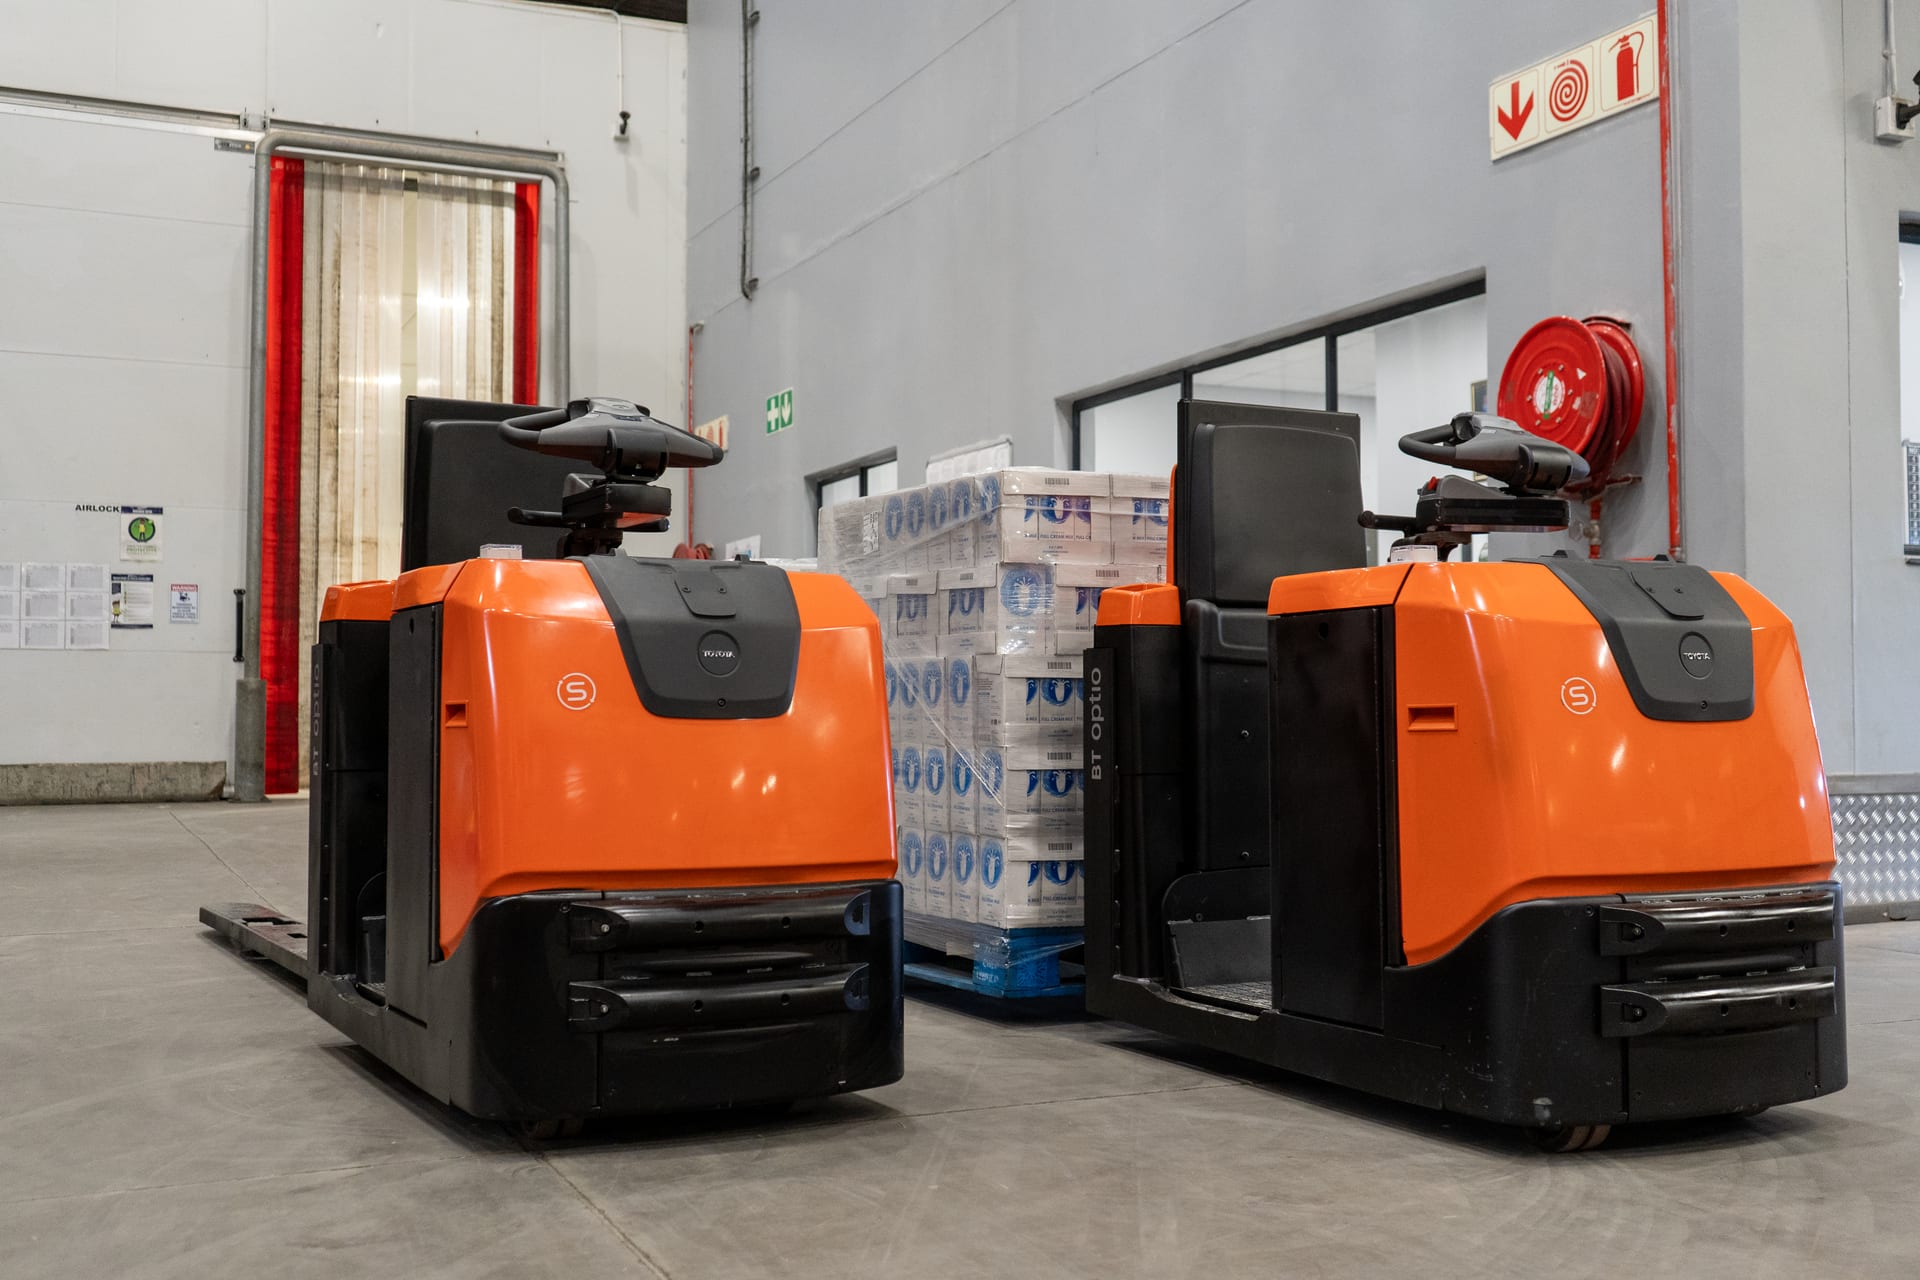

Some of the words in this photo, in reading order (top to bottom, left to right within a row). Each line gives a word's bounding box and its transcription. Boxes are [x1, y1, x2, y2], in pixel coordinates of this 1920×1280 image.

[75, 504, 120, 512] AIRLOCK
[703, 650, 736, 658] TOYOTA
[1683, 652, 1711, 660] TOYOTA
[566, 681, 588, 702] S
[1569, 685, 1589, 706] S
[1089, 667, 1105, 741] optio
[1091, 750, 1102, 780] BT
